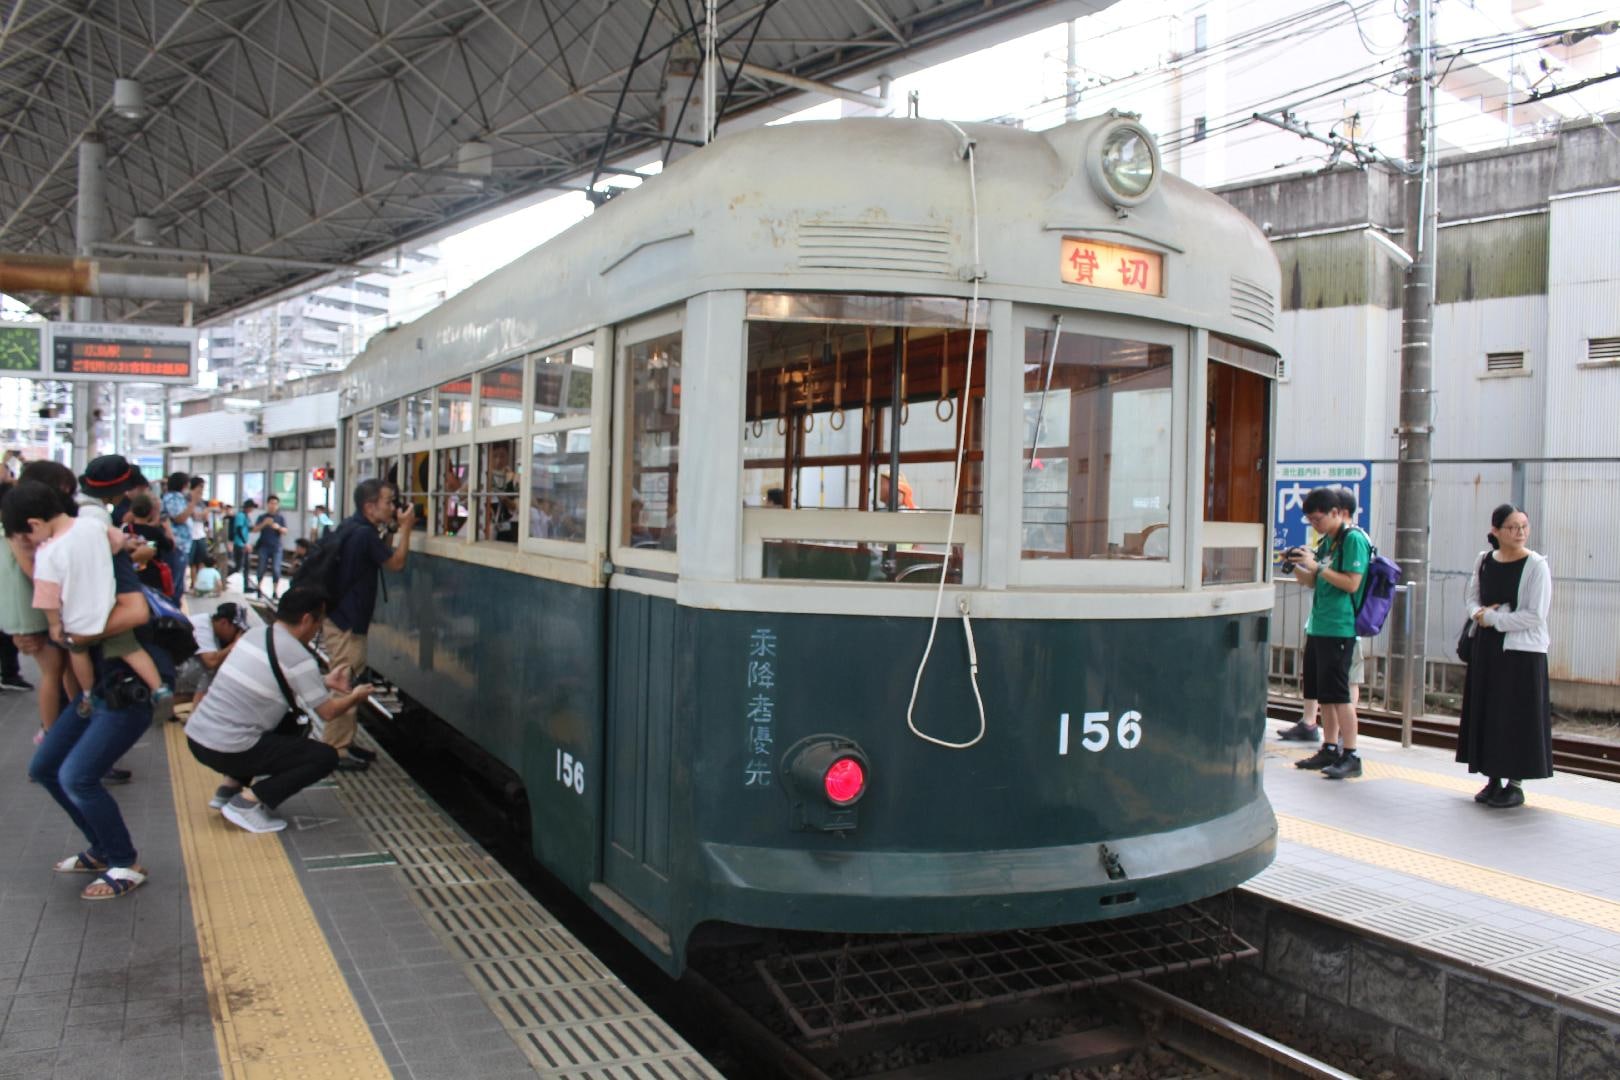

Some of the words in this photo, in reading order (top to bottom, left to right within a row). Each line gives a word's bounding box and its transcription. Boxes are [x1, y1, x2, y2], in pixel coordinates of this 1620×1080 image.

[1069, 247, 1149, 290] 貸切
[1058, 710, 1142, 755] 156
[556, 748, 585, 795] 156
